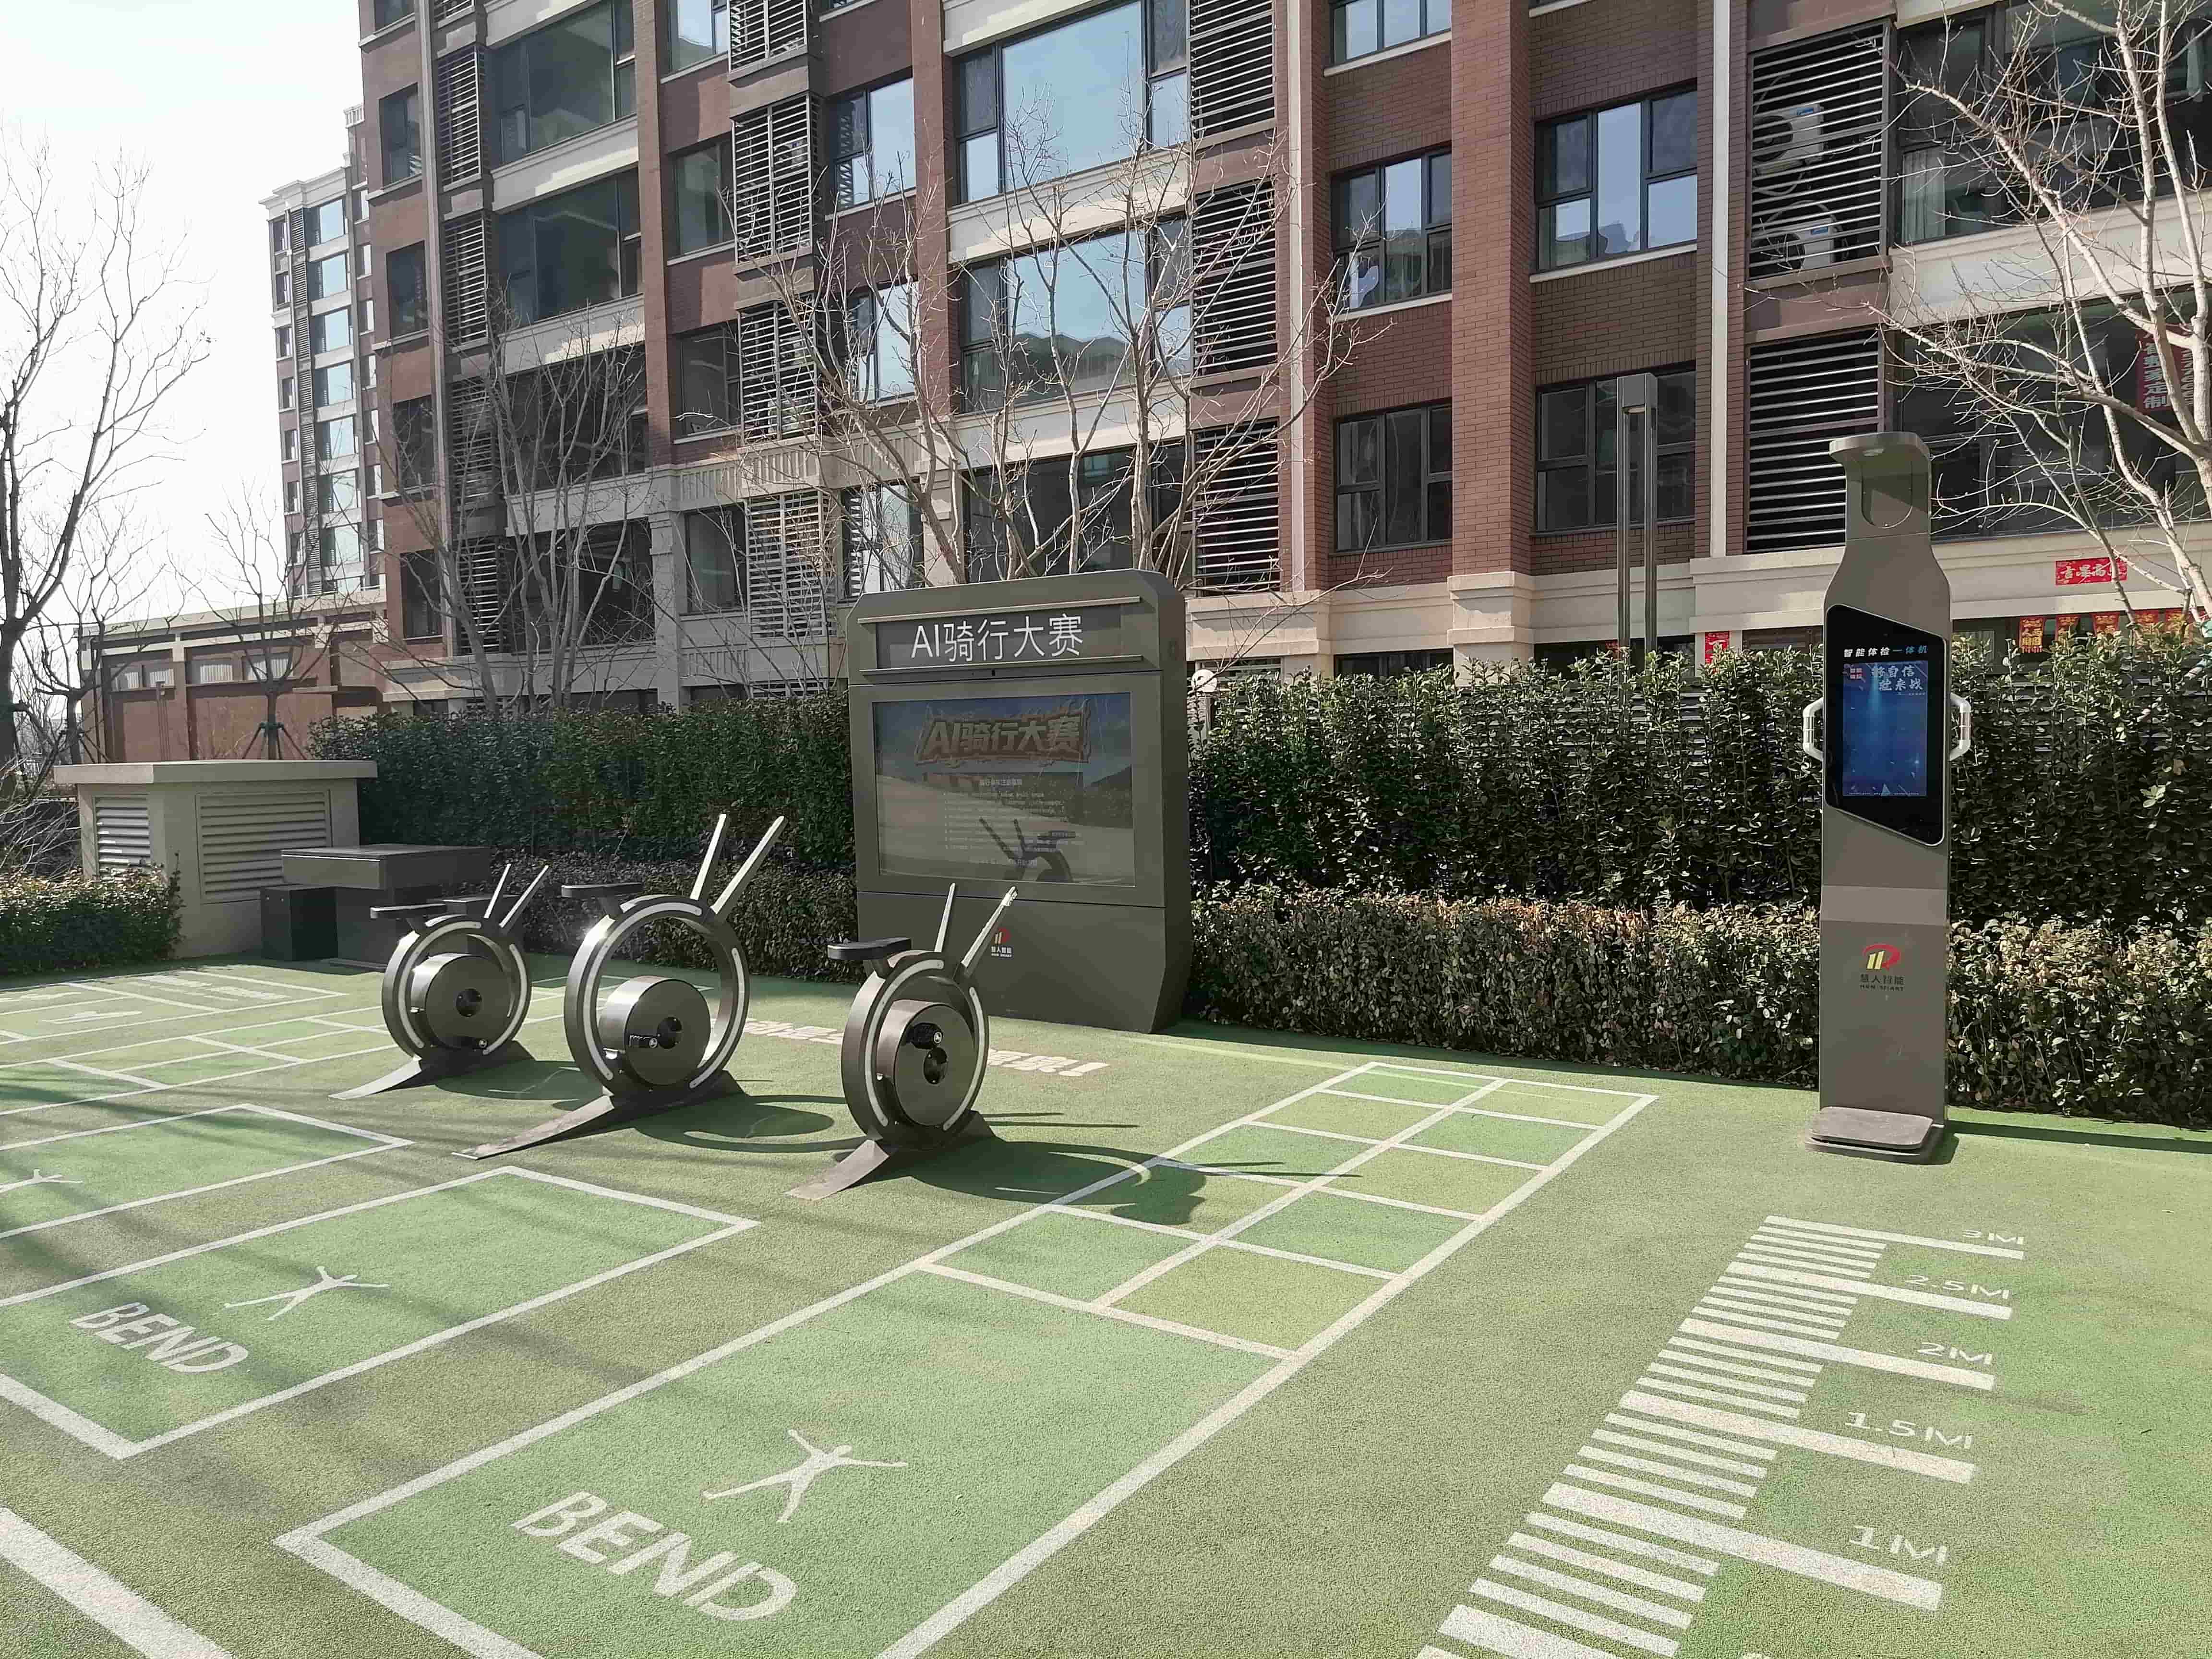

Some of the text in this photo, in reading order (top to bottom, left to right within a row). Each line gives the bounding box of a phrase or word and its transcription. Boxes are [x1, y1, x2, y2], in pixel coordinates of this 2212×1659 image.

[911, 613, 1083, 661] AI骑行大赛
[1844, 645, 1928, 657] 智能体检一体机
[924, 715, 1081, 755] AI骑行大赛
[1962, 1229, 2024, 1245] 3M
[1905, 1274, 2010, 1299] 2.5M
[69, 1302, 249, 1374] BEND
[1917, 1342, 1993, 1365] 2M
[1845, 1411, 1973, 1450] 1.5M
[509, 1490, 798, 1622] BEND
[1849, 1525, 1948, 1566] 1M
